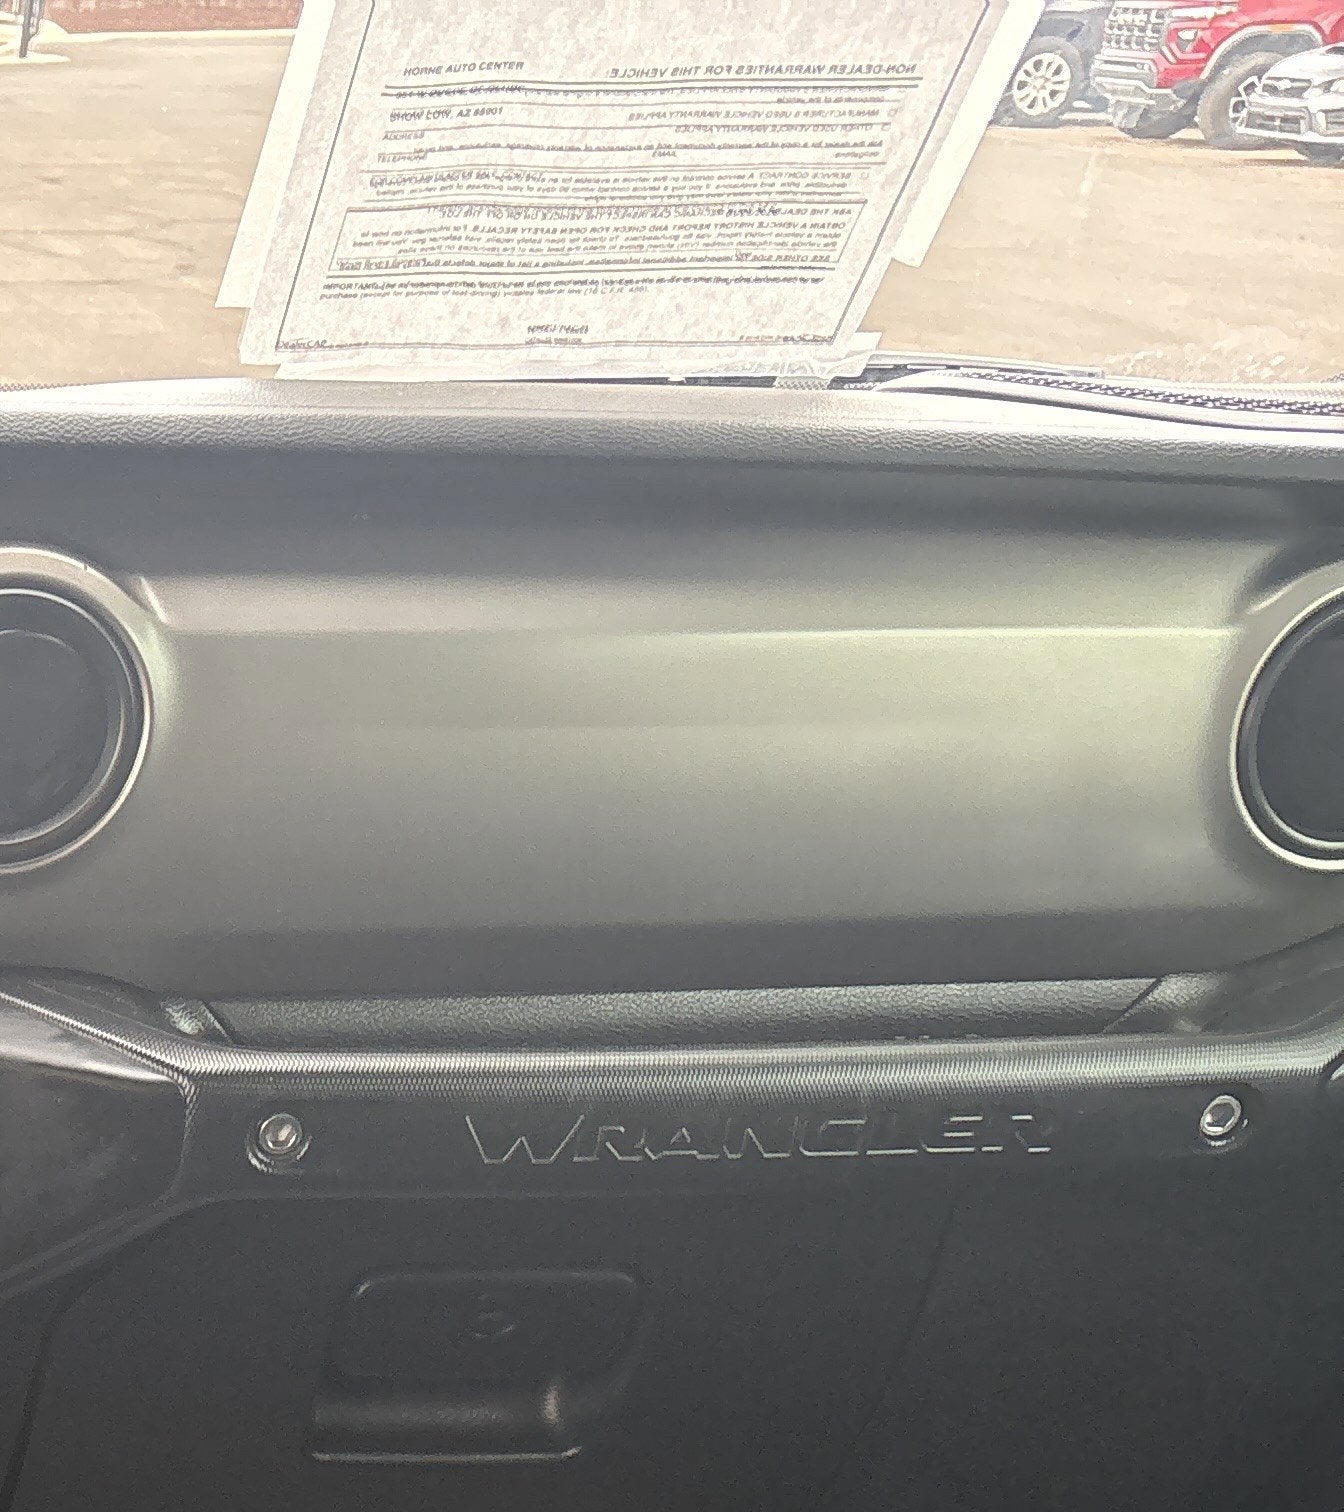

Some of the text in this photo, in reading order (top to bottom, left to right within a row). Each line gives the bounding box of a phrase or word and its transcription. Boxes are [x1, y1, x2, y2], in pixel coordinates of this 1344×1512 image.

[445, 62, 476, 74] AUTO
[479, 61, 524, 71] CENTER
[457, 108, 471, 118] AZ
[464, 1112, 1054, 1164] WRANGLER
